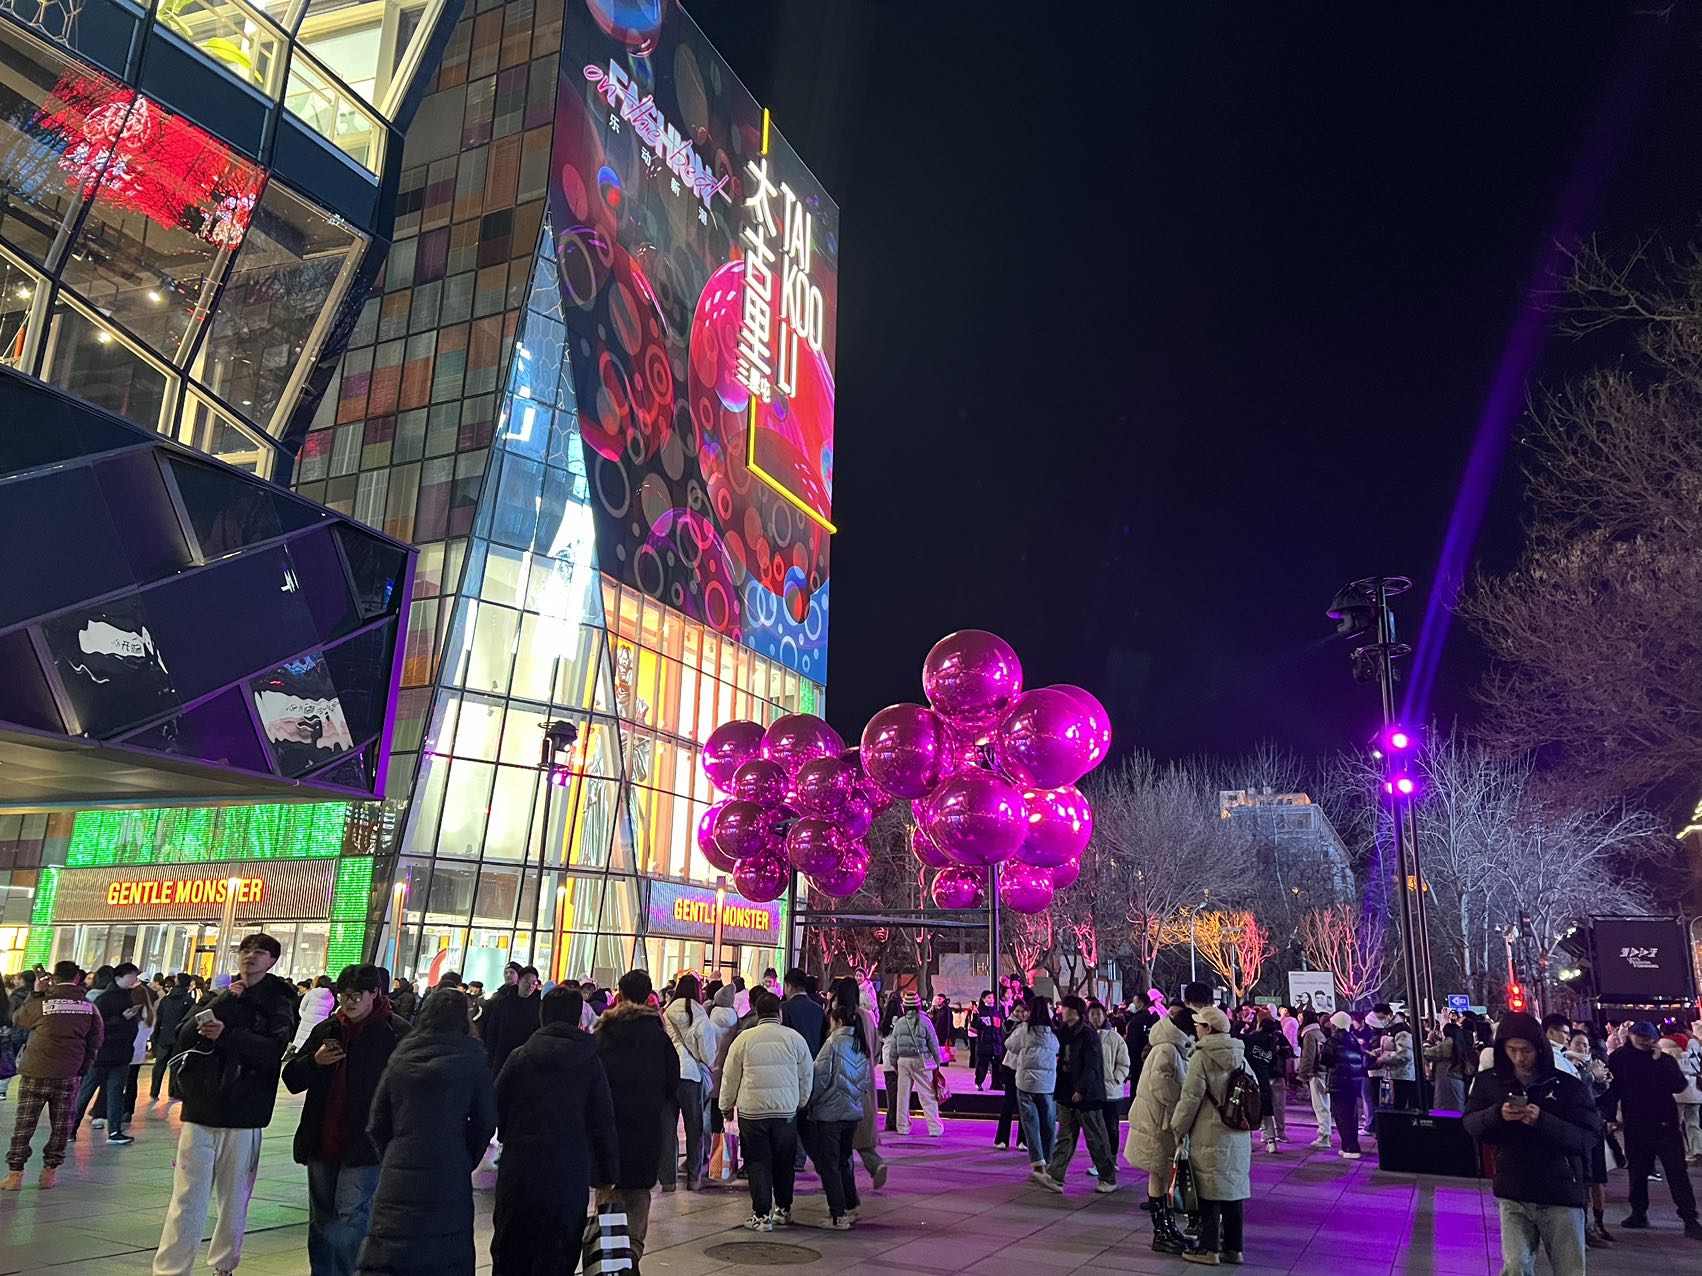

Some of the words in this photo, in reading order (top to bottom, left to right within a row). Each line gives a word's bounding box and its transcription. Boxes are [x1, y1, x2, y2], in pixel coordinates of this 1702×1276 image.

[738, 158, 778, 376] 太古里
[780, 182, 812, 274] TAI
[780, 253, 823, 352] KOO
[777, 321, 798, 398] LI
[107, 881, 173, 905] GENTLE
[175, 878, 264, 903] MONSER
[722, 906, 769, 931] MONSTER
